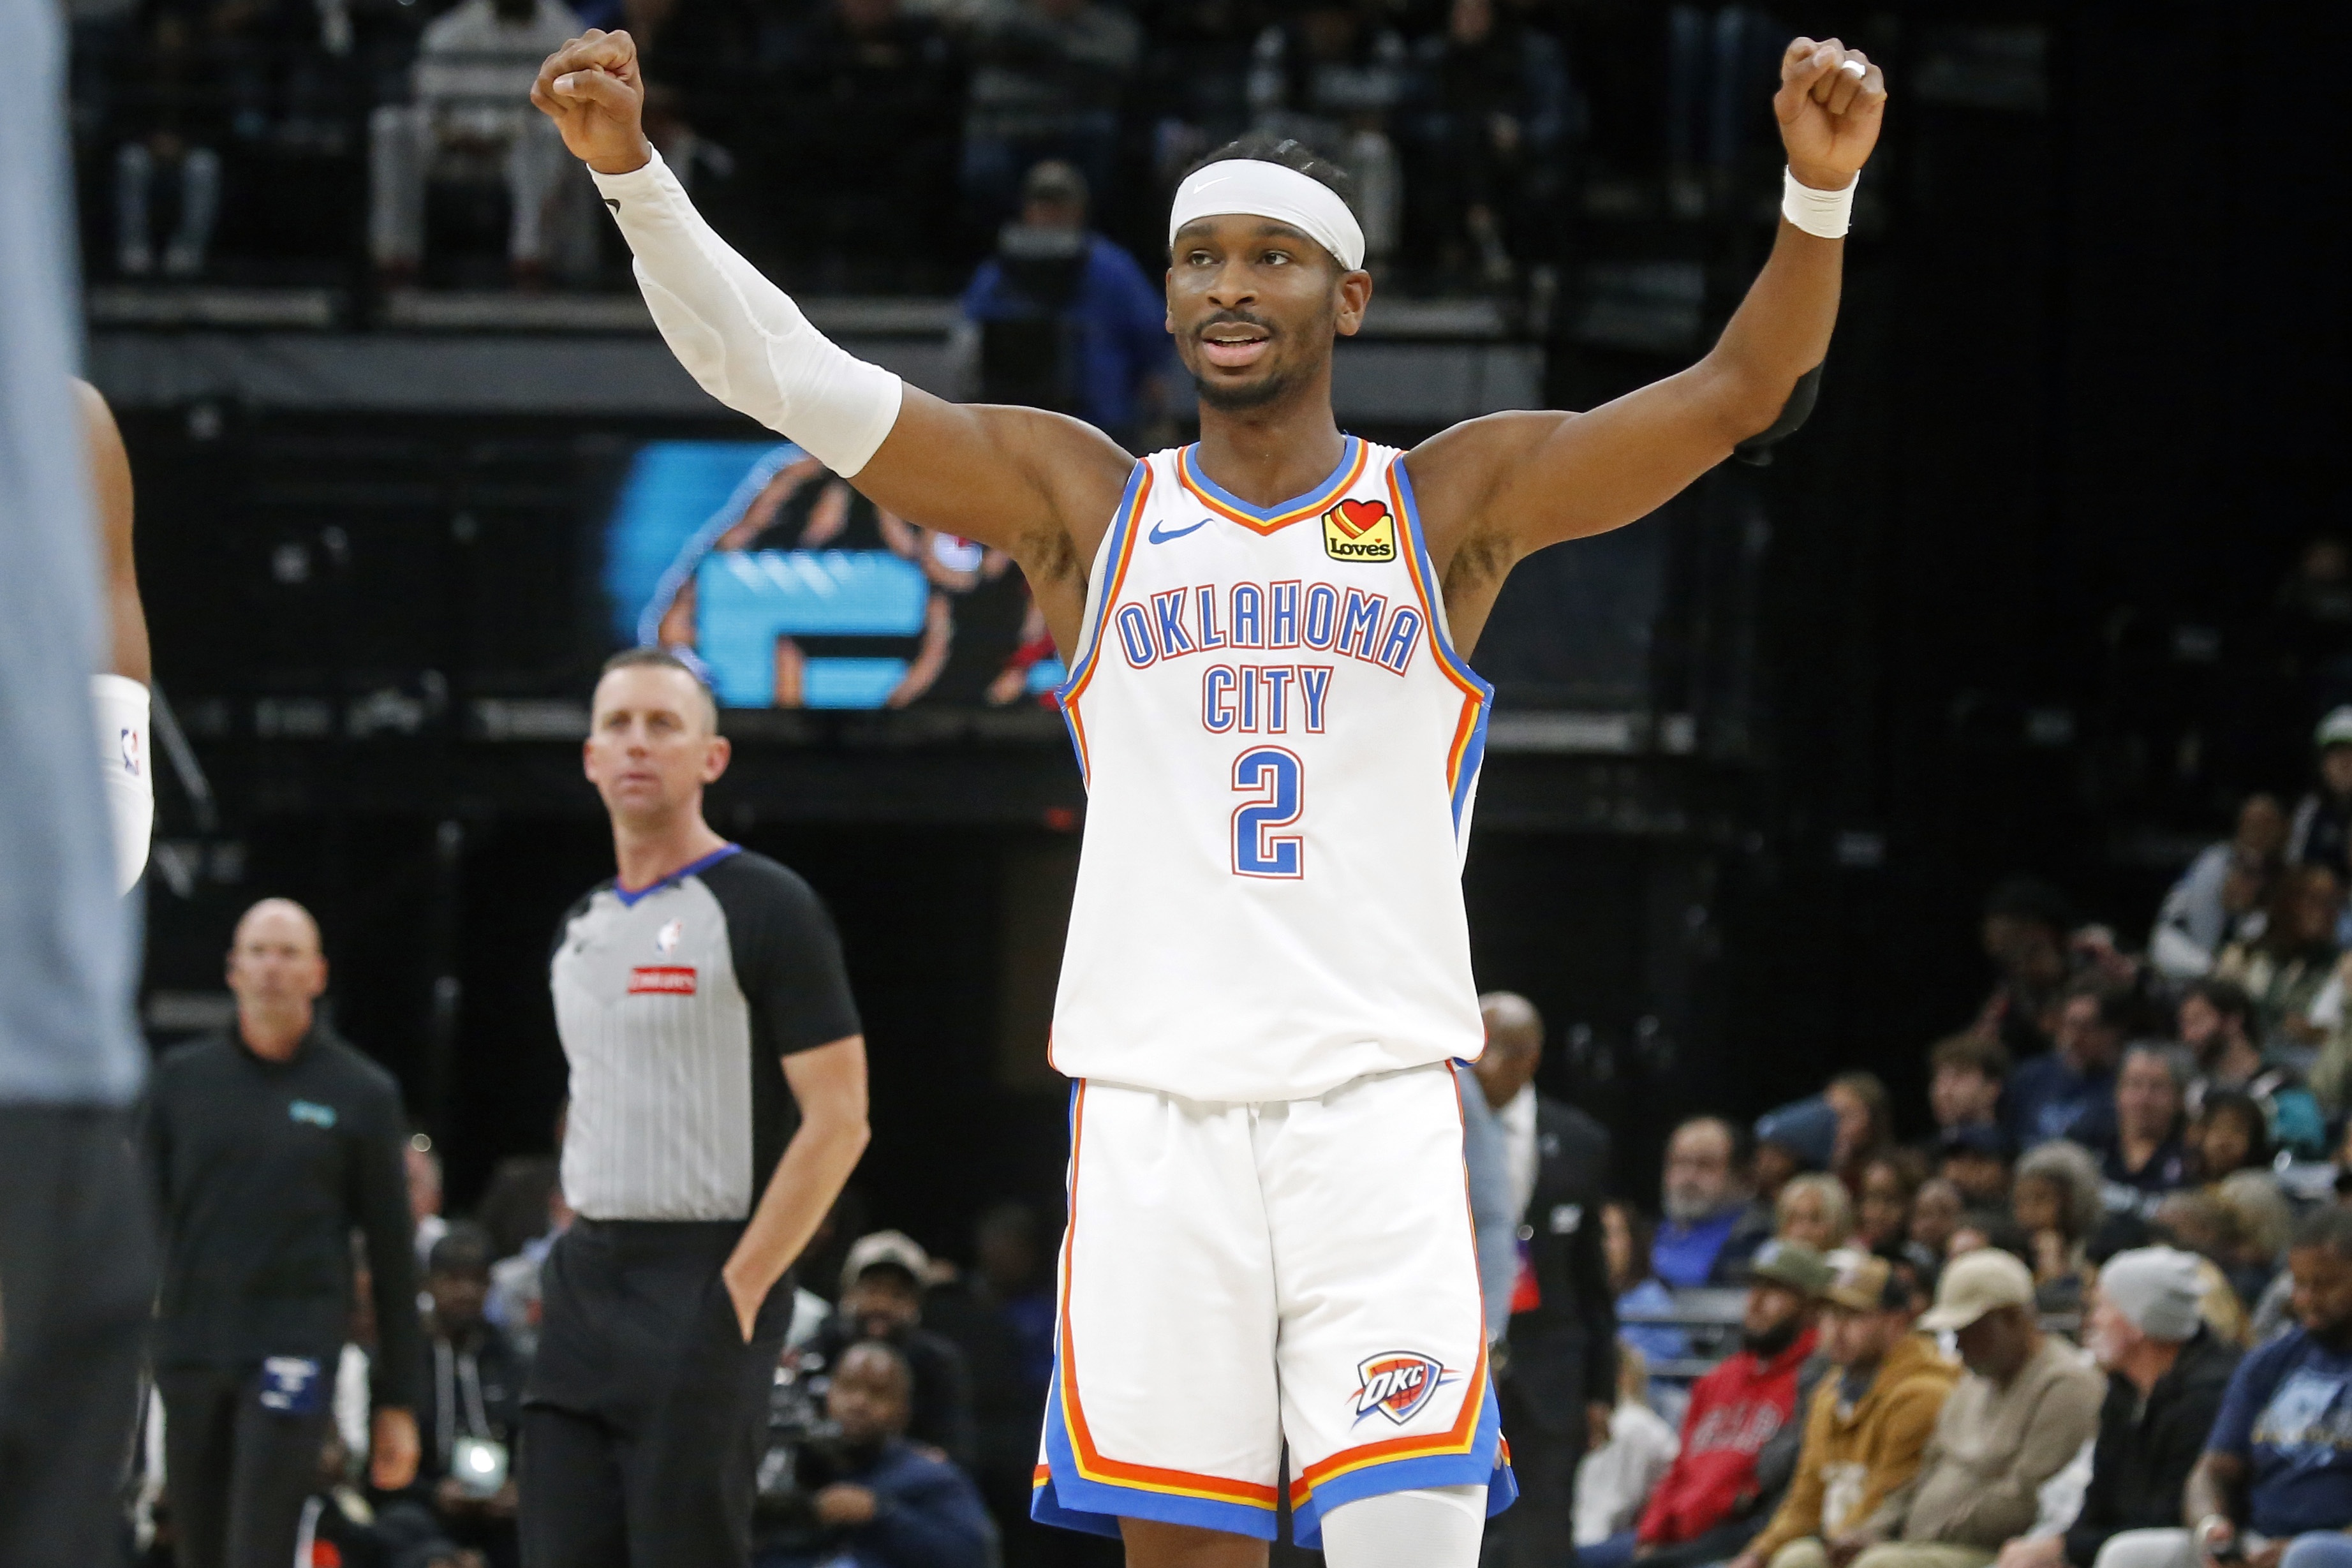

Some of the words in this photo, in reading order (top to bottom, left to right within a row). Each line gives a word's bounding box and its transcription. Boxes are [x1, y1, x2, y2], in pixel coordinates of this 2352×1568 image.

[1115, 579, 1423, 677] OKLAHOMA
[1202, 664, 1334, 734] CITY
[1231, 744, 1304, 880] 2
